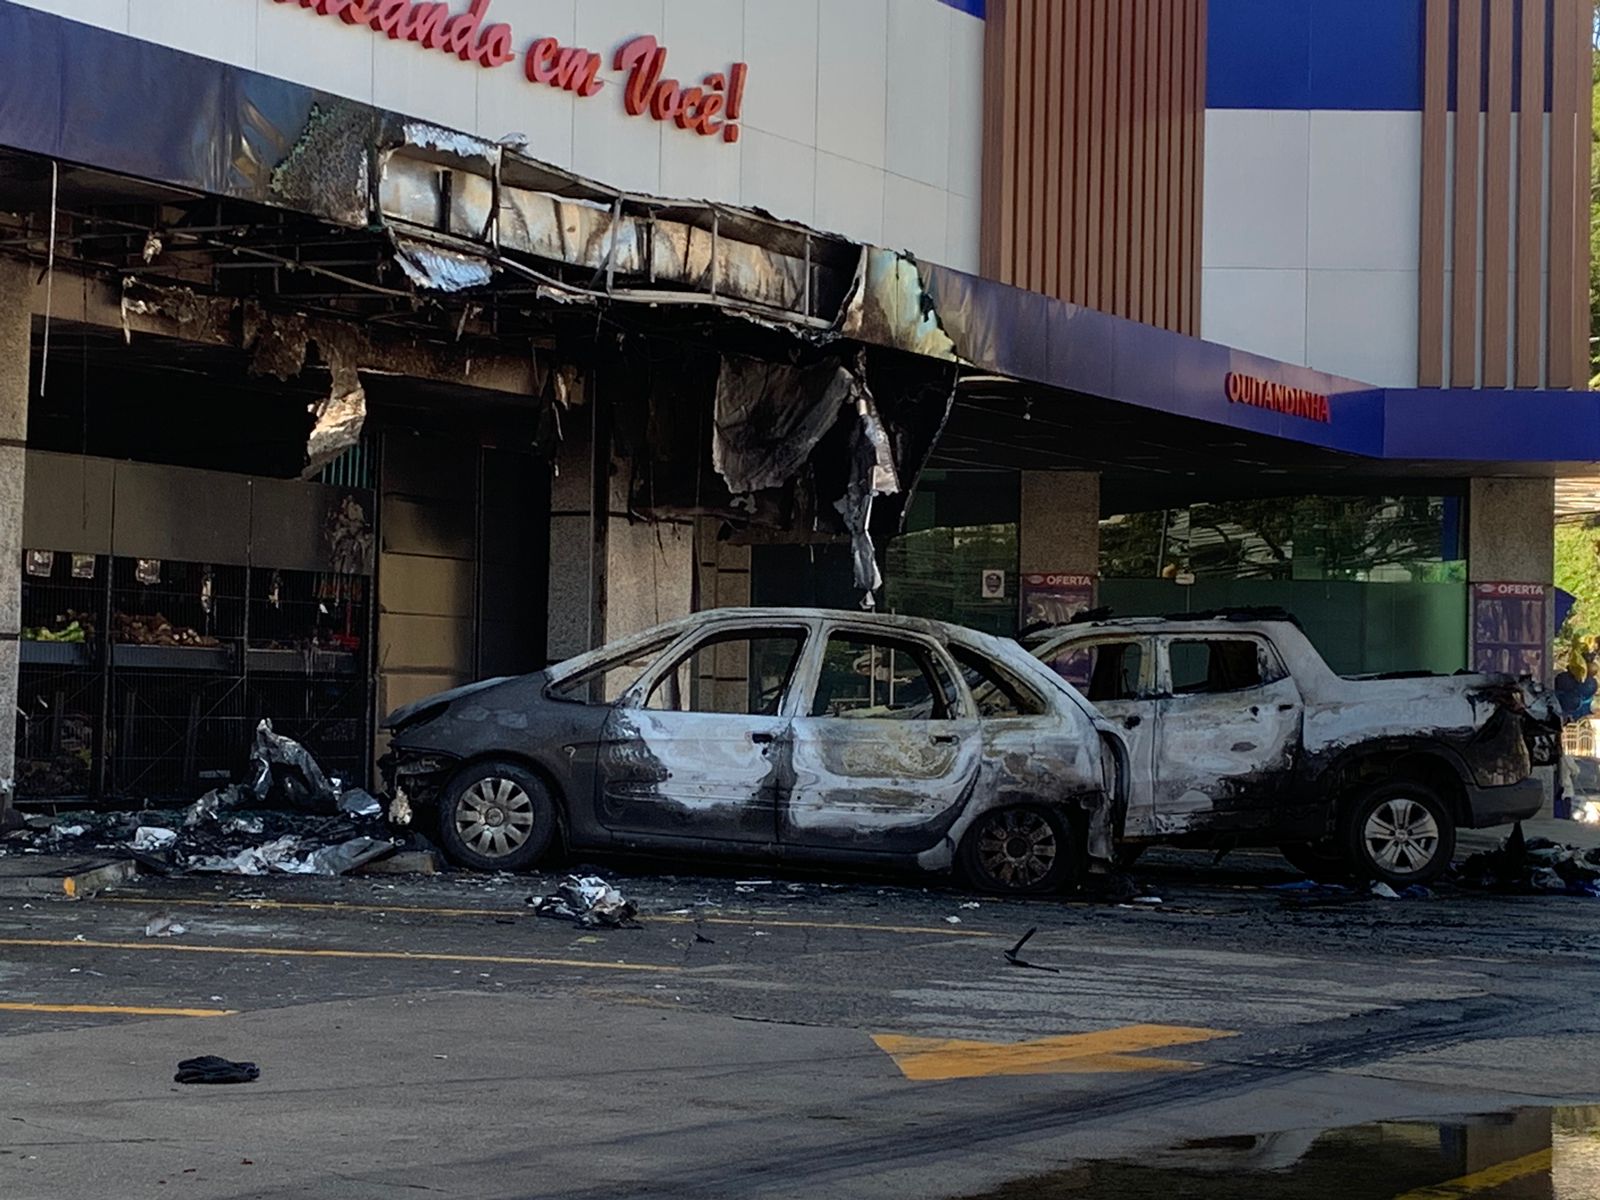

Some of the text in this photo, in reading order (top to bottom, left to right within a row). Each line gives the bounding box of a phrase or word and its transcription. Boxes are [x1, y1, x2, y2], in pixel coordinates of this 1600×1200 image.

[273, 0, 748, 143] sando em Você!
[1046, 575, 1092, 586] OFERTA
[1498, 584, 1544, 595] OFERTA
